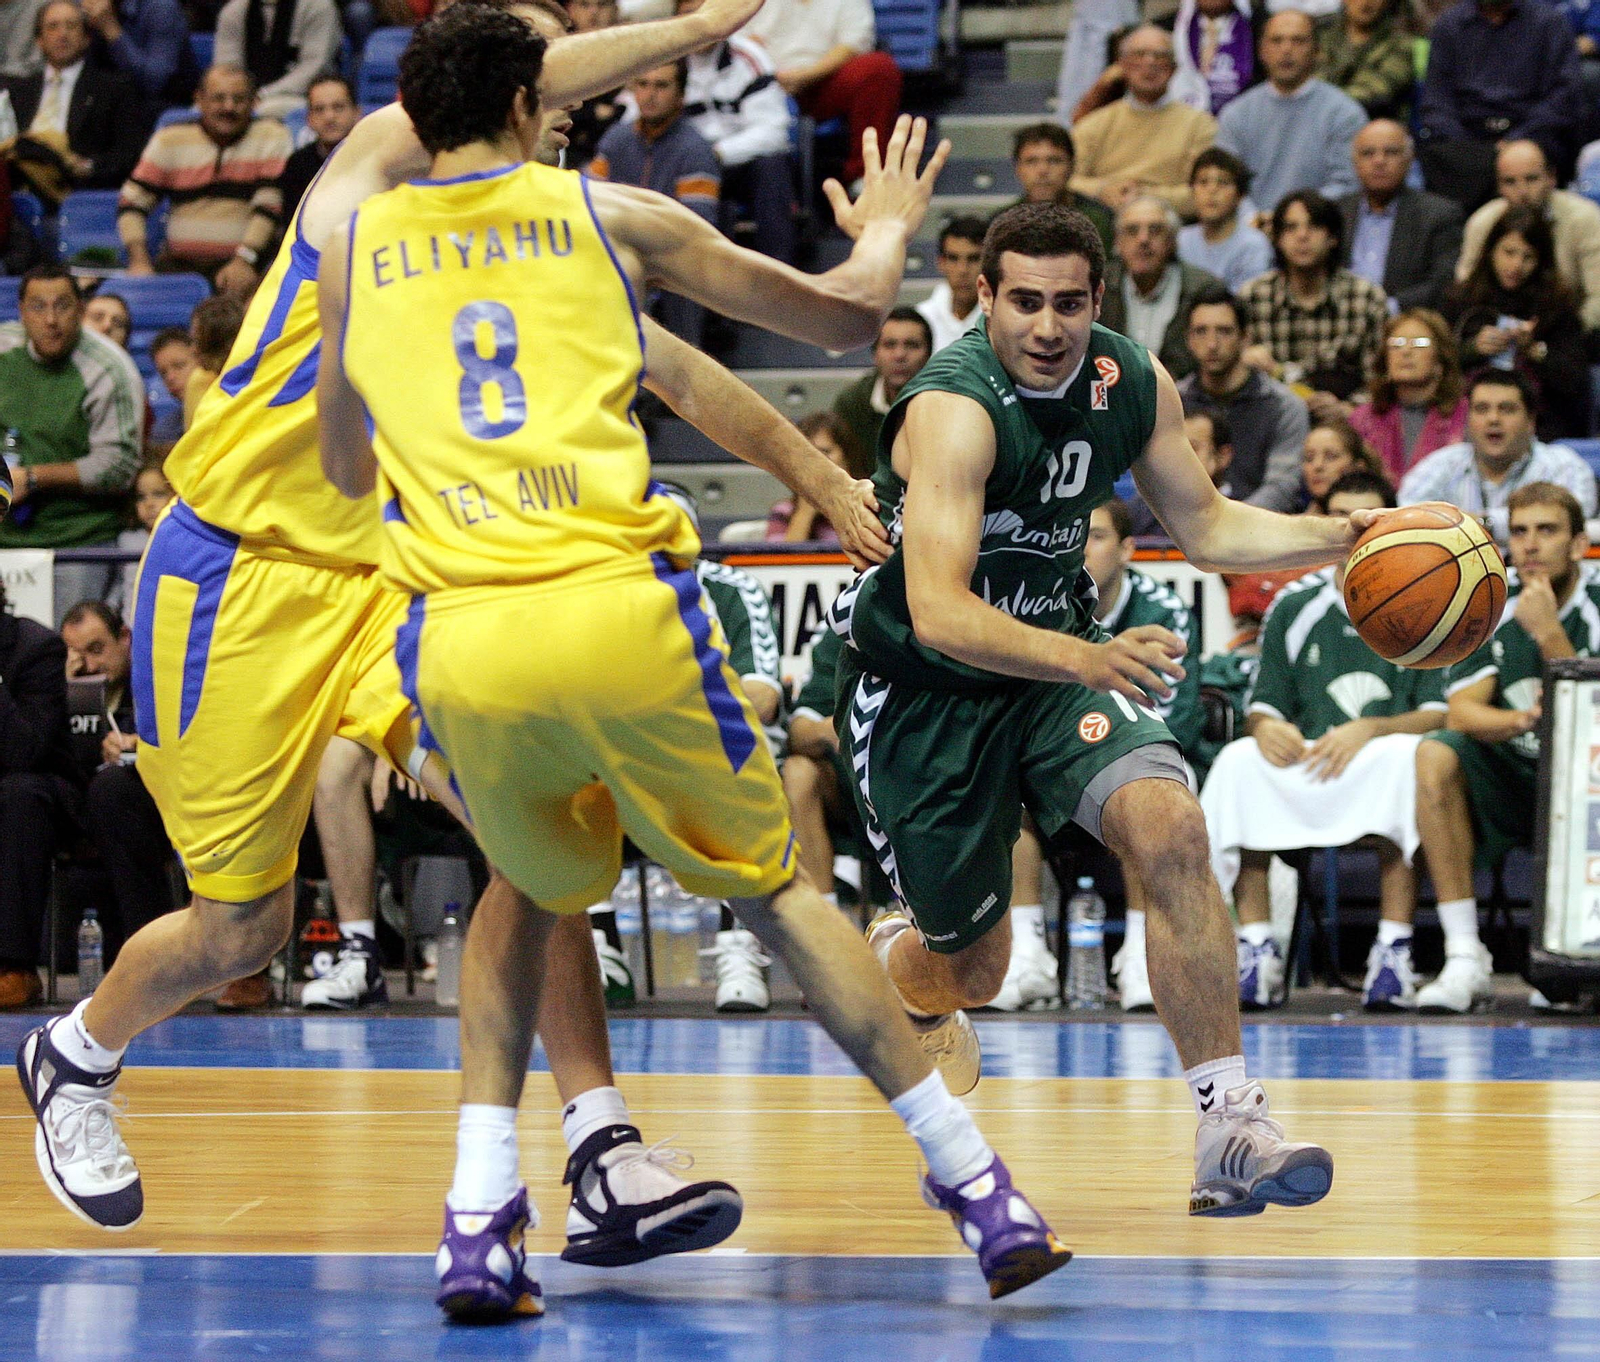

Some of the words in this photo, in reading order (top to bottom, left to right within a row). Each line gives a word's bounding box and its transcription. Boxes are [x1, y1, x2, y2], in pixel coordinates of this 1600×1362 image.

[372, 218, 573, 288] ELIYAHU
[451, 300, 527, 440] 8
[438, 480, 498, 527] TEL
[517, 462, 579, 511] AVIV
[1040, 440, 1092, 504] 10
